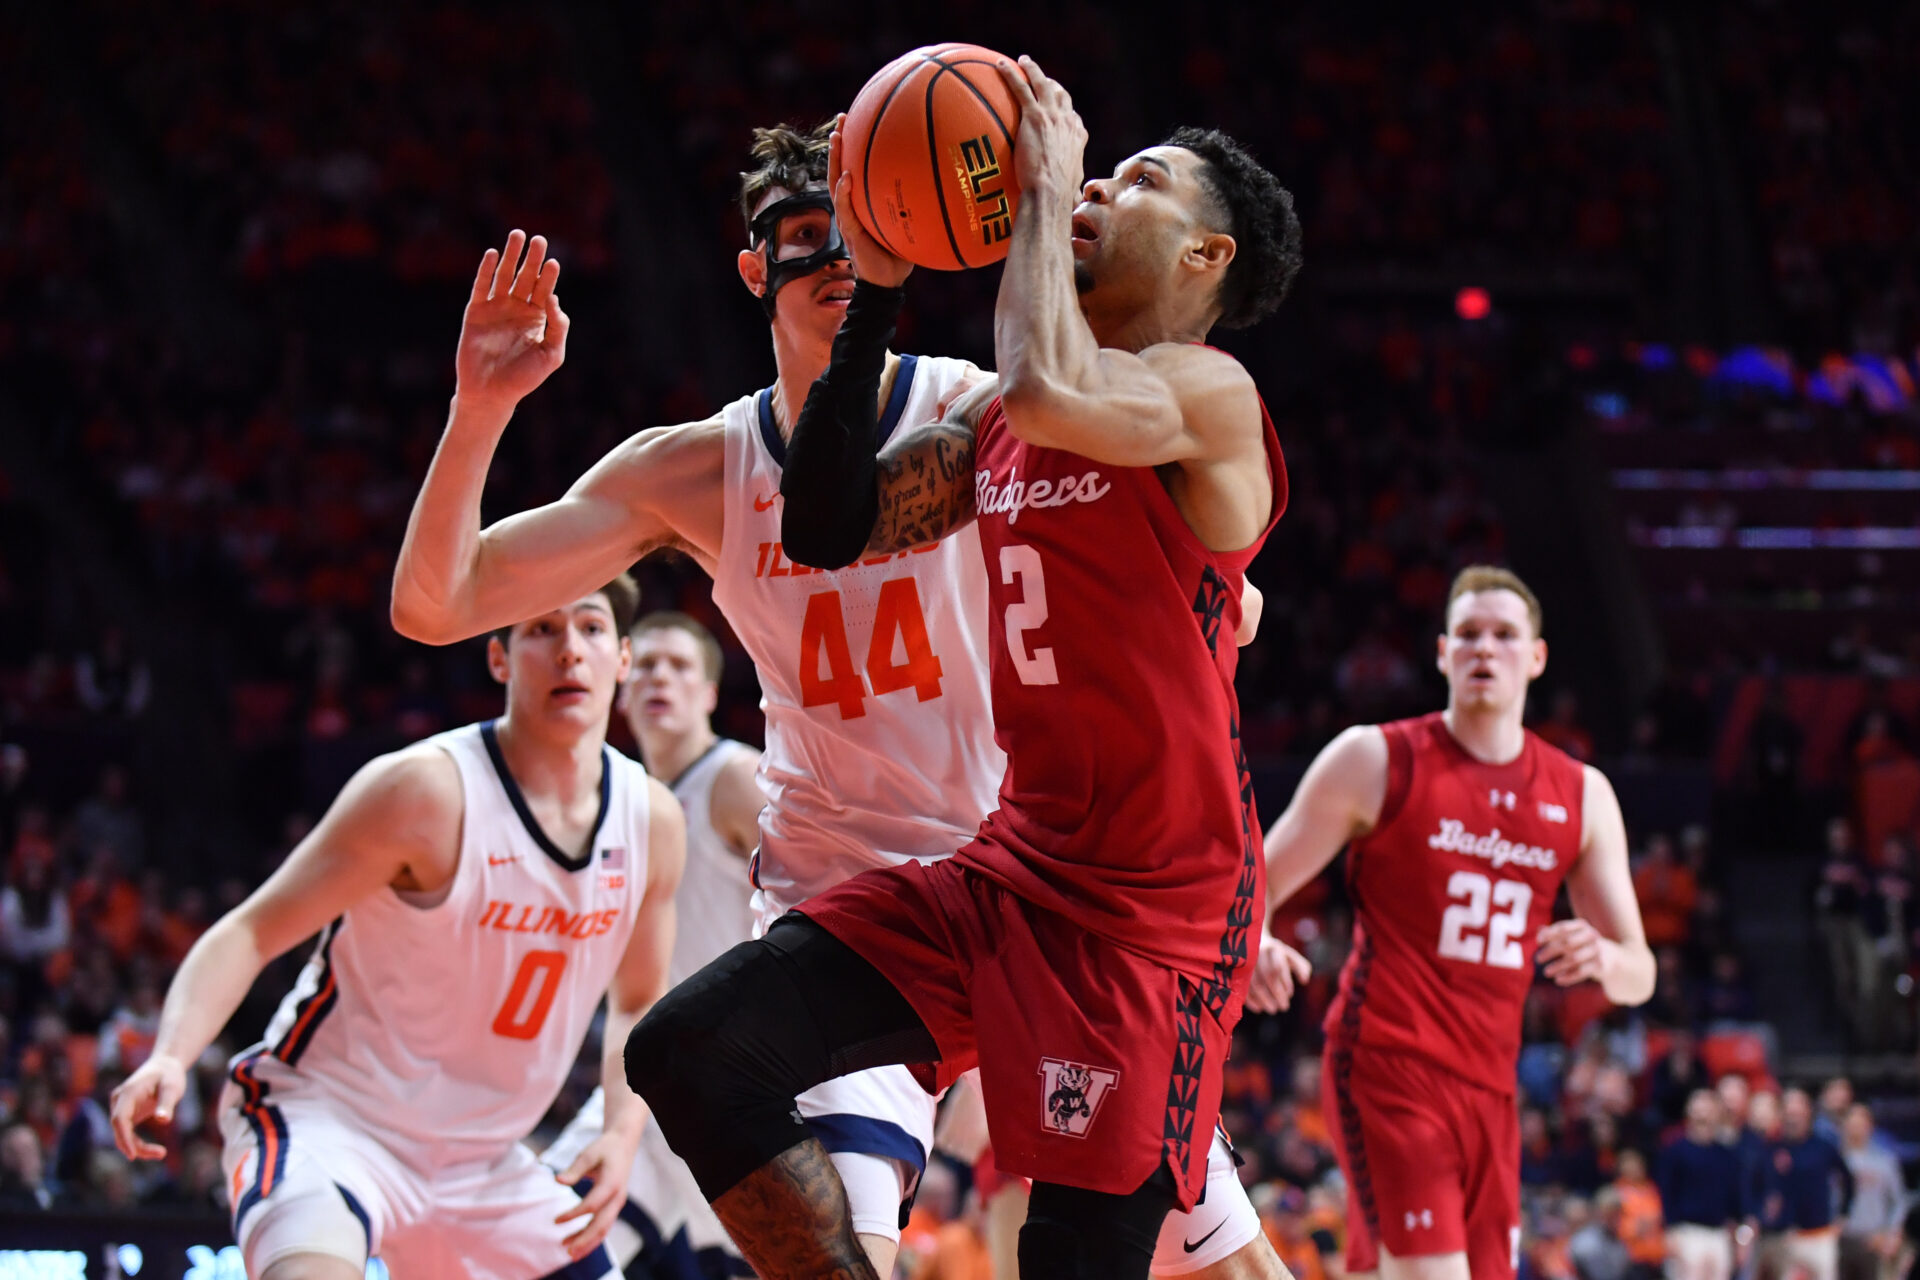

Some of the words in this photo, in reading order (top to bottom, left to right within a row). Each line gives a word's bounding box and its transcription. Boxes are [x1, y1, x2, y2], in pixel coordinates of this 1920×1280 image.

[960, 134, 1012, 246] ELITE
[975, 466, 1112, 525] Badgers
[800, 576, 943, 720] 44
[999, 544, 1060, 686] 2
[1428, 817, 1558, 870] Badgers
[1437, 870, 1533, 969] 22
[491, 949, 567, 1040] 0
